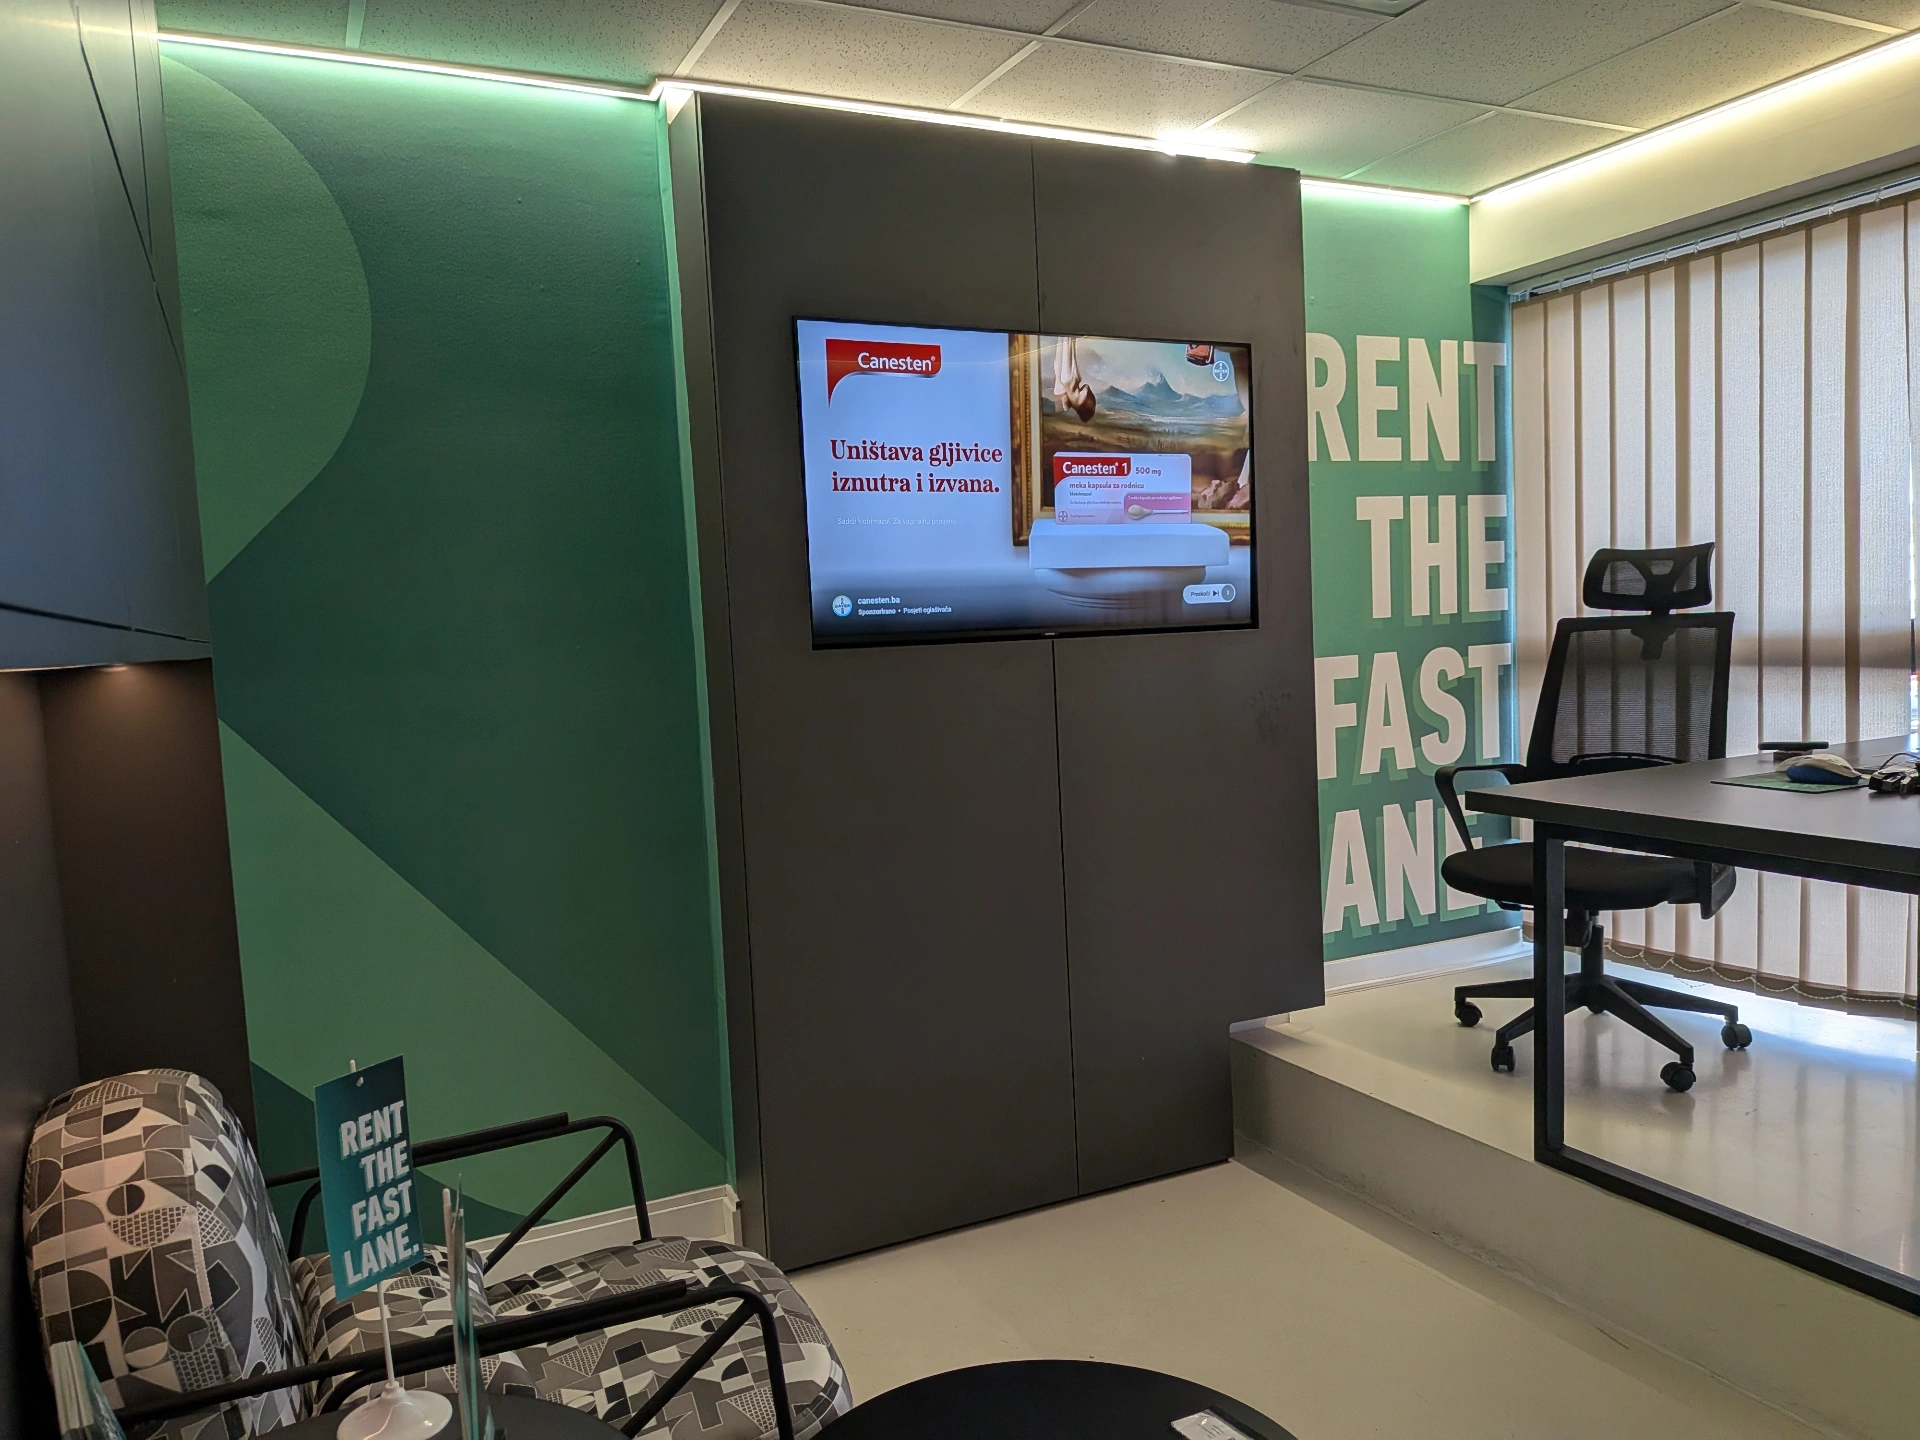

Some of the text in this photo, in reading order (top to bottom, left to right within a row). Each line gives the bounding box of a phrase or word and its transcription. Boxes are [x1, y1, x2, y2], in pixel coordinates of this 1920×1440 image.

[1305, 333, 1507, 462] RENT
[830, 439, 1003, 467] Uništava gljivice
[1121, 462, 1128, 475] 1
[1135, 467, 1151, 475] 500
[1151, 469, 1162, 477] mg
[832, 471, 1000, 493] iznutra i izvana.
[1069, 481, 1087, 489] meka
[1087, 481, 1112, 490] kapsula
[1356, 494, 1509, 618] THE
[857, 596, 901, 605] canesten.ba
[857, 608, 897, 616] Sponzorirano
[1314, 643, 1512, 780] FAST
[340, 1100, 404, 1158] RENT
[360, 1140, 410, 1192] THE
[352, 1180, 412, 1239] FAST
[343, 1223, 420, 1286] LANE.
